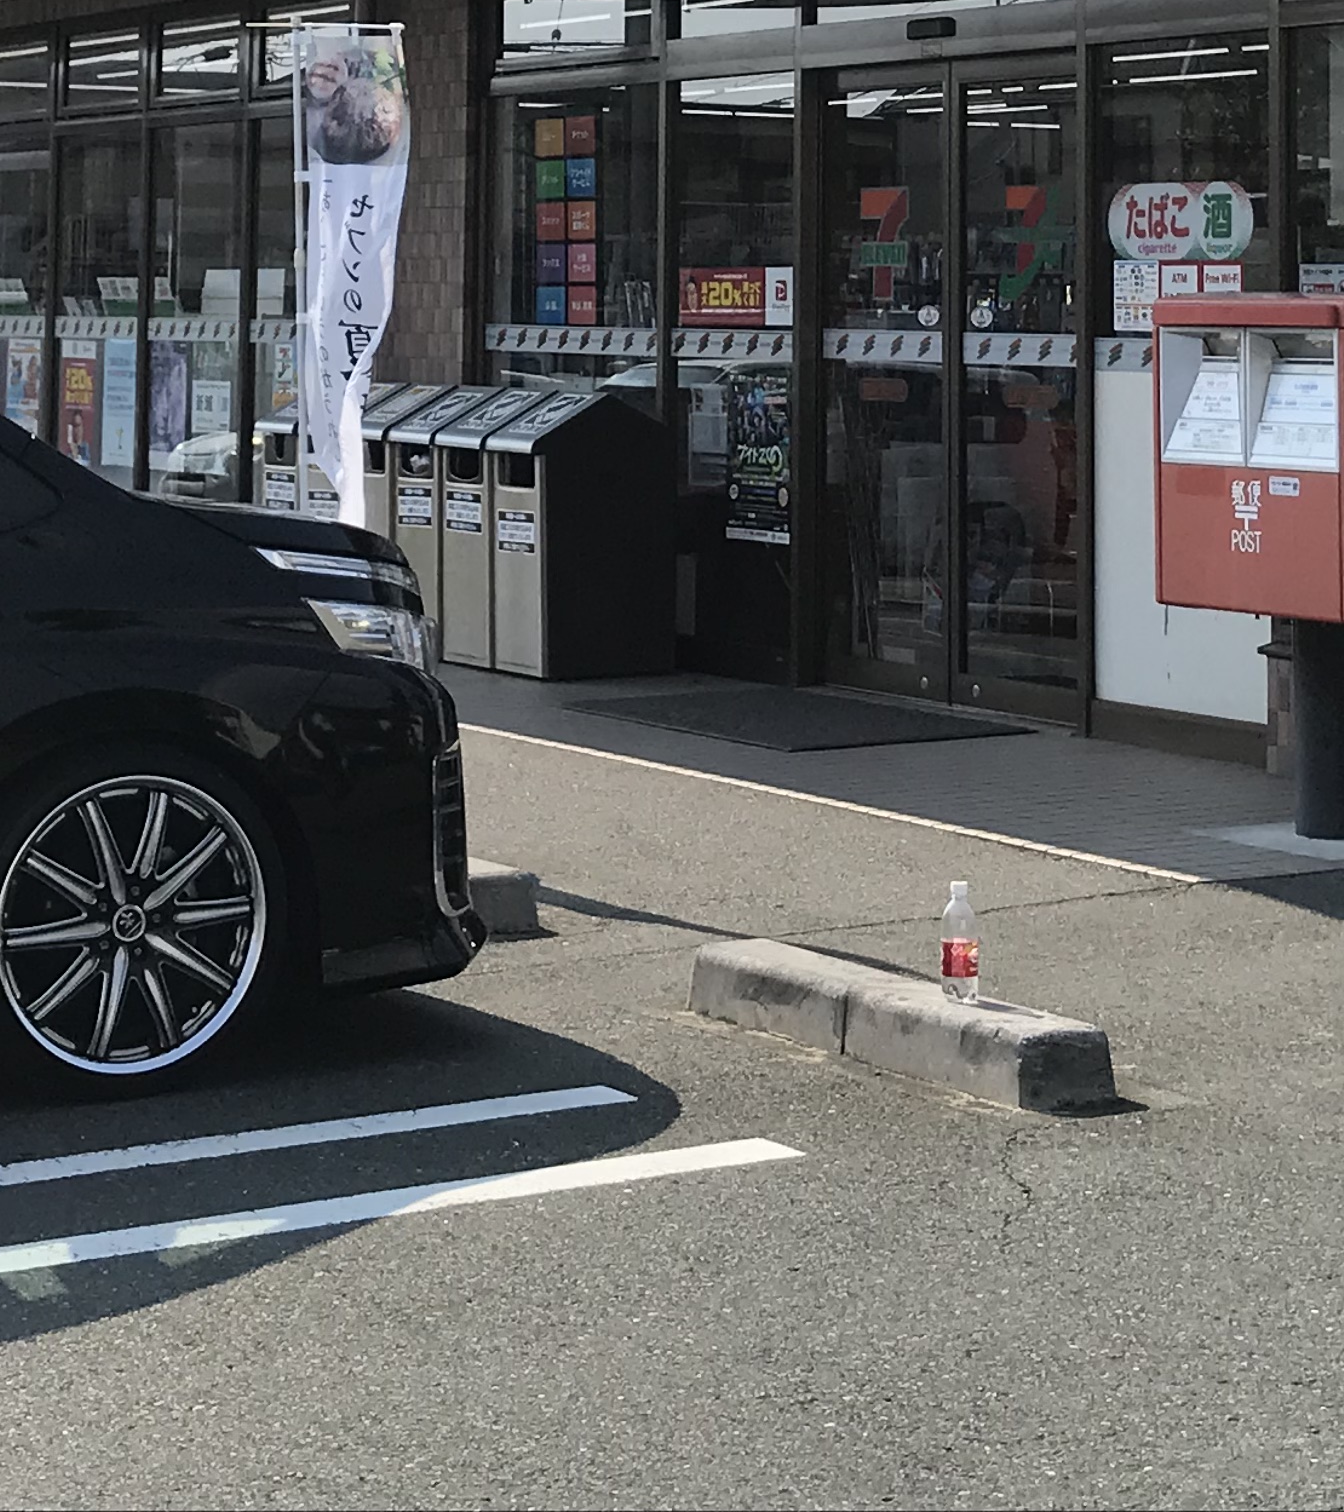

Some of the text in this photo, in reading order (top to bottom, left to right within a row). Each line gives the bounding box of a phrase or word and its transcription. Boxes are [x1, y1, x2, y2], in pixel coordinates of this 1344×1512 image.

[1126, 192, 1190, 240] たばこ
[1203, 192, 1233, 239] 酒
[1137, 243, 1178, 256] cigarette
[1171, 273, 1188, 285] ATM
[1231, 479, 1262, 507] 郵便
[1231, 529, 1262, 554] POST
